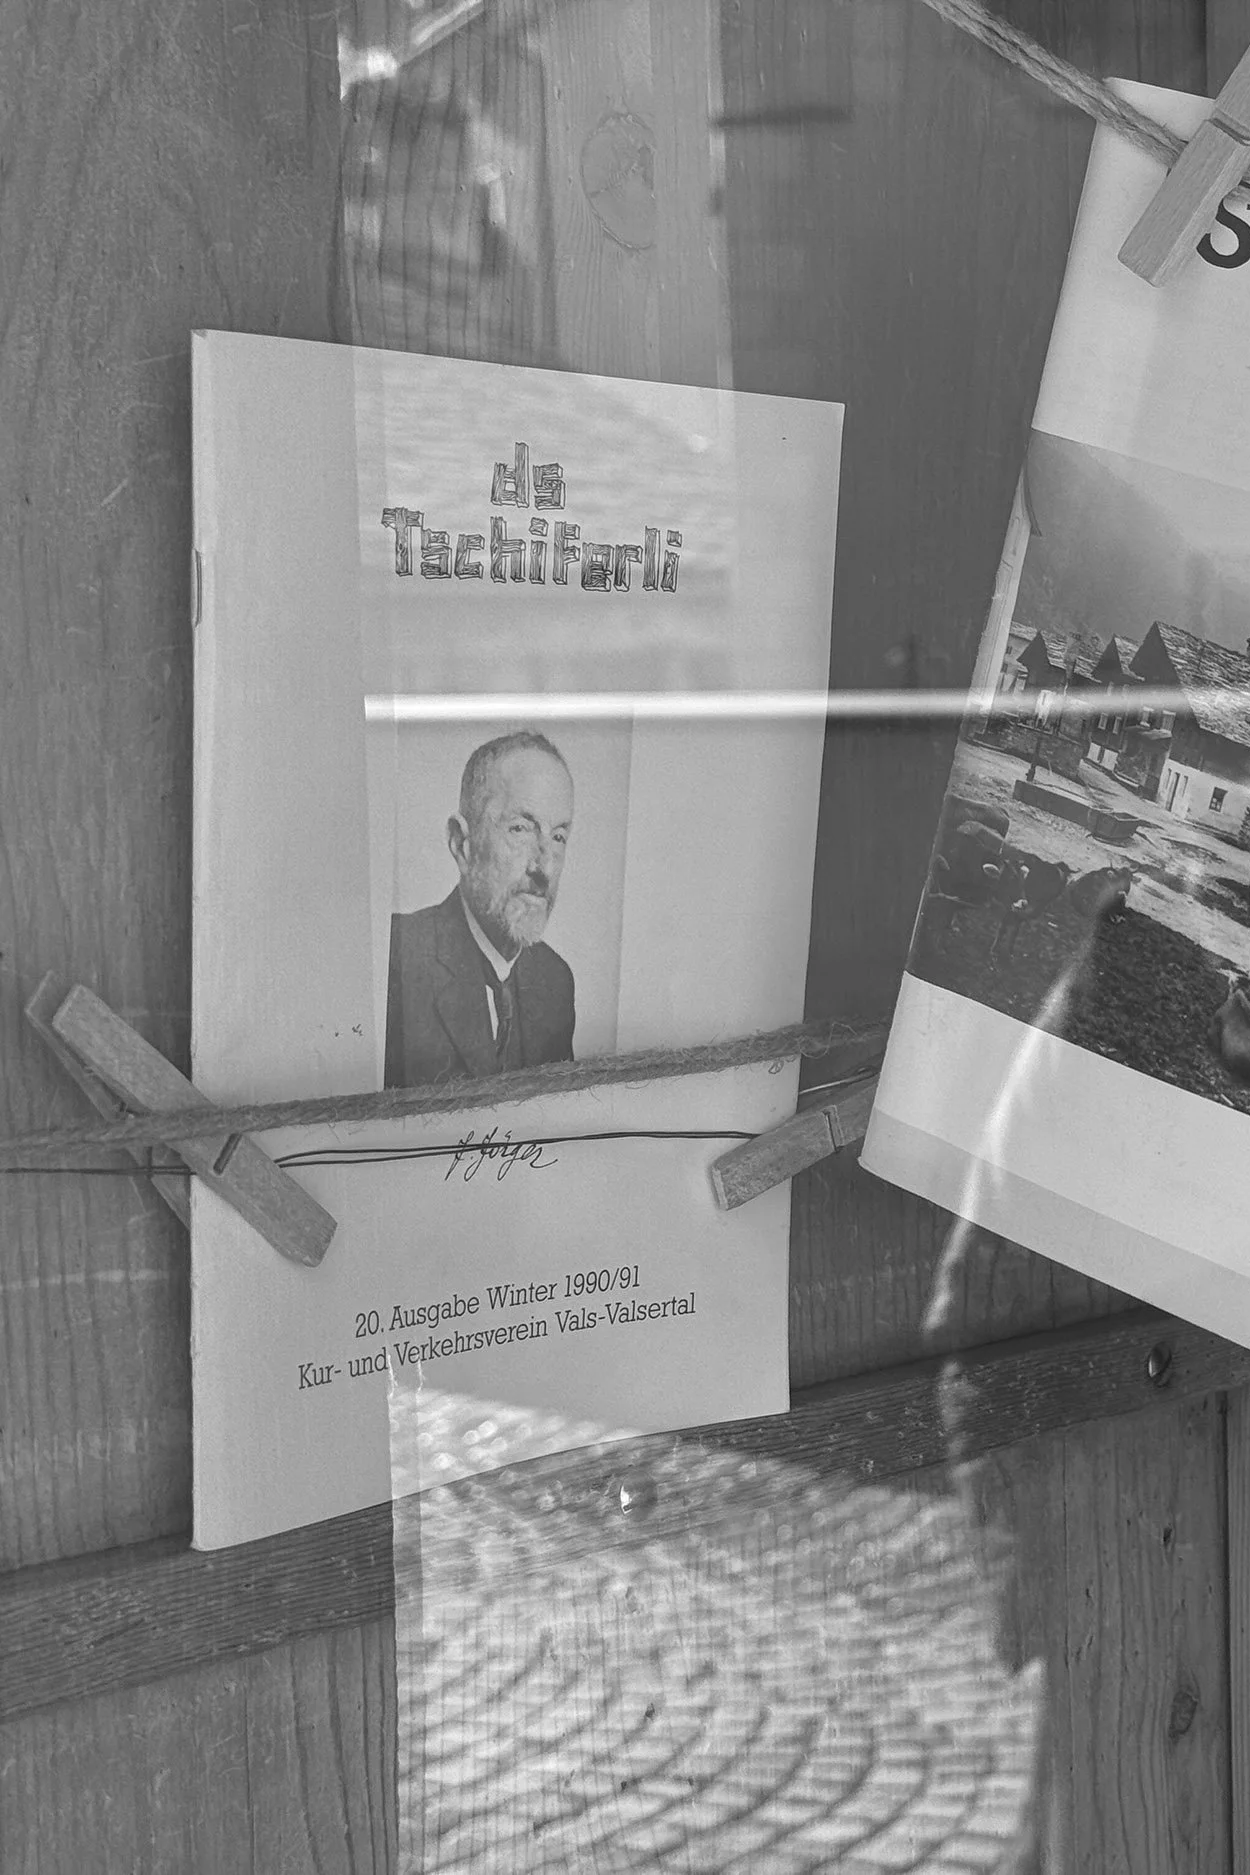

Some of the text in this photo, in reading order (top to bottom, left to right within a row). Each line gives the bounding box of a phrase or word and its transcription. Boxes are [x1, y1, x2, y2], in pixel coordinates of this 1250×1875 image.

[490, 441, 566, 510] ds
[380, 506, 683, 593] Tschiferli
[297, 1292, 697, 1391] Kur- und Verkehrsverein Vals-Valsertal
[354, 1265, 641, 1339] 20. Ausgabe Winter 1990/91
